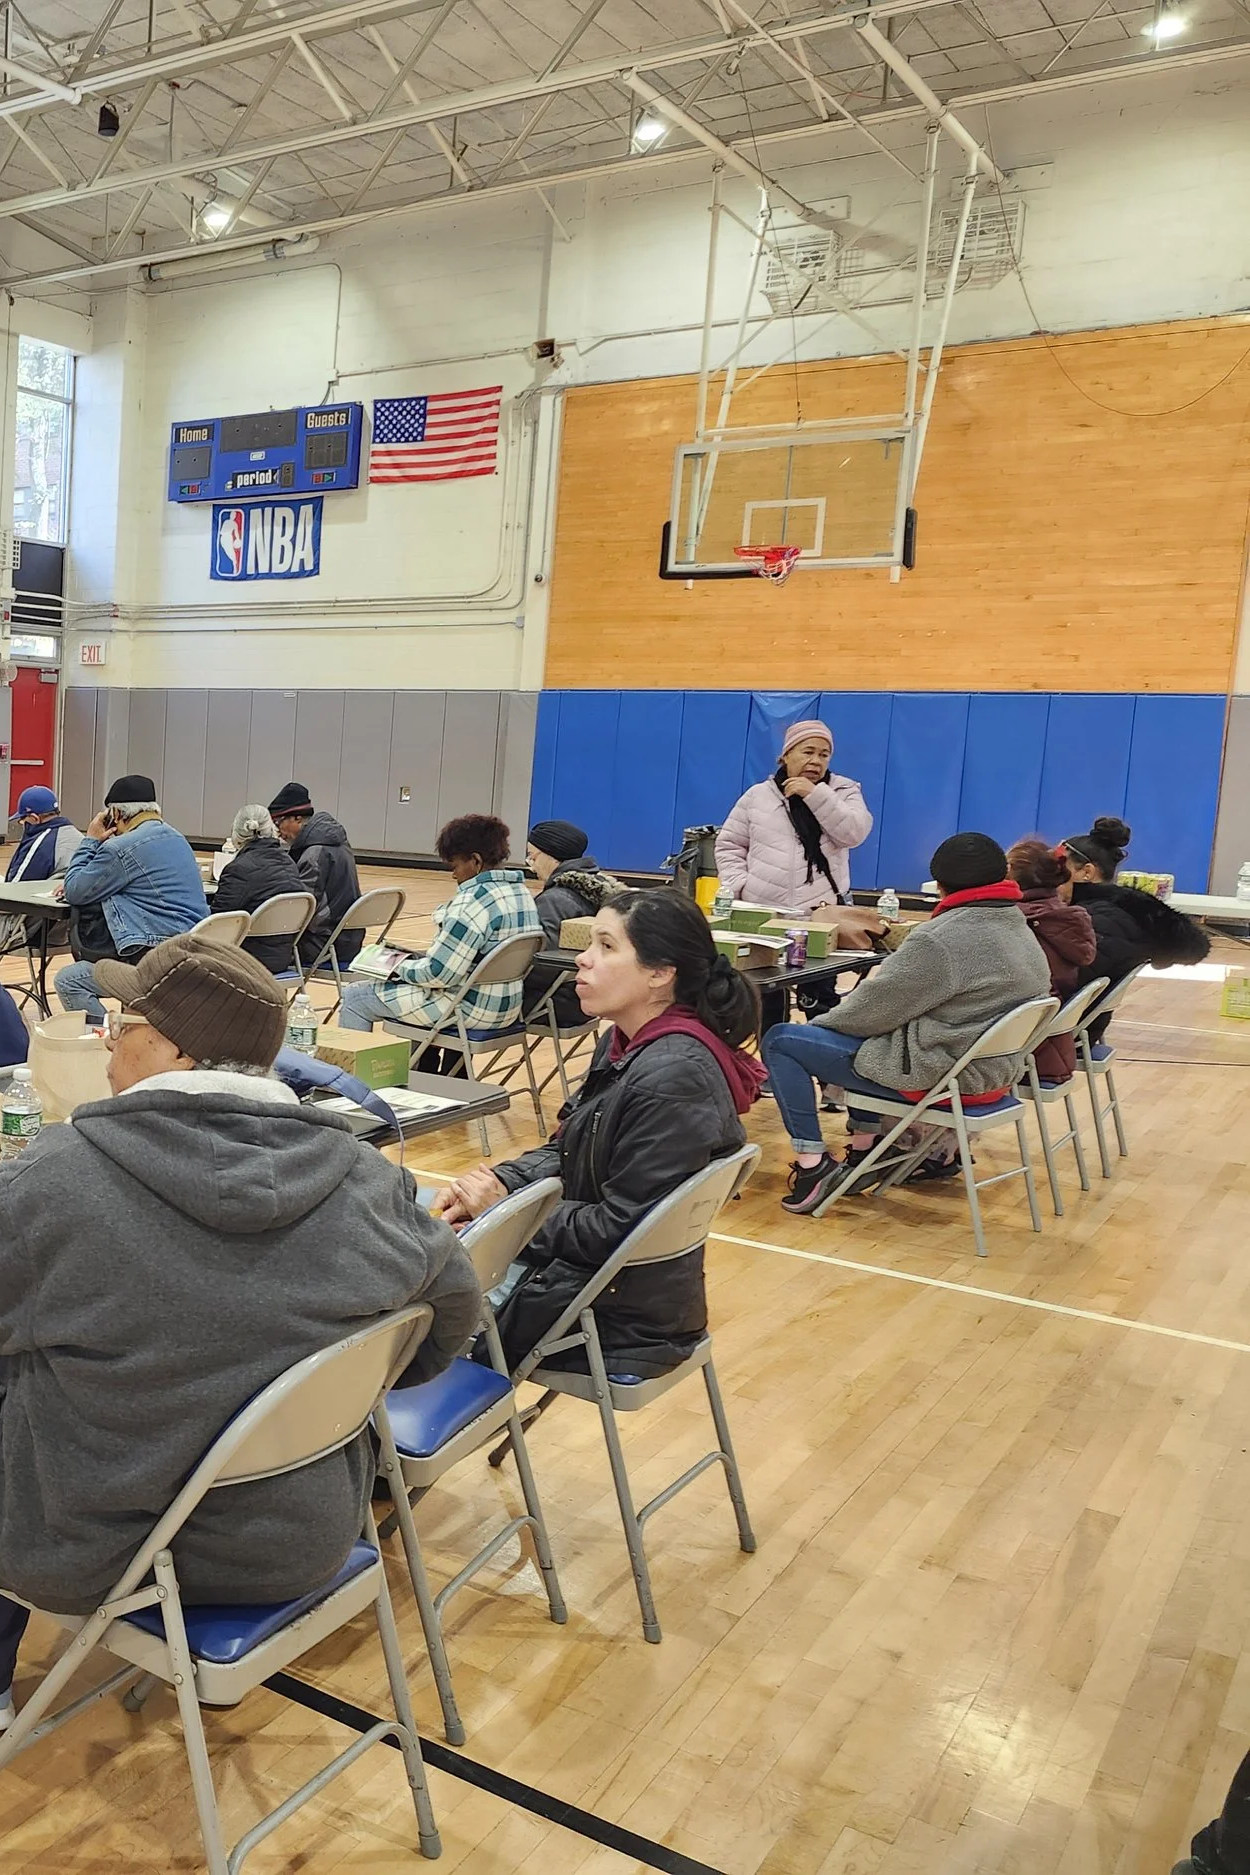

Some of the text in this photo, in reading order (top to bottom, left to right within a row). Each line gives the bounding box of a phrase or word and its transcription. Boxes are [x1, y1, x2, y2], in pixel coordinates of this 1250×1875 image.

[306, 411, 346, 429] Guests
[180, 427, 208, 443] Home
[236, 469, 272, 488] period
[246, 503, 314, 575] NBA
[81, 645, 102, 663] EXIT
